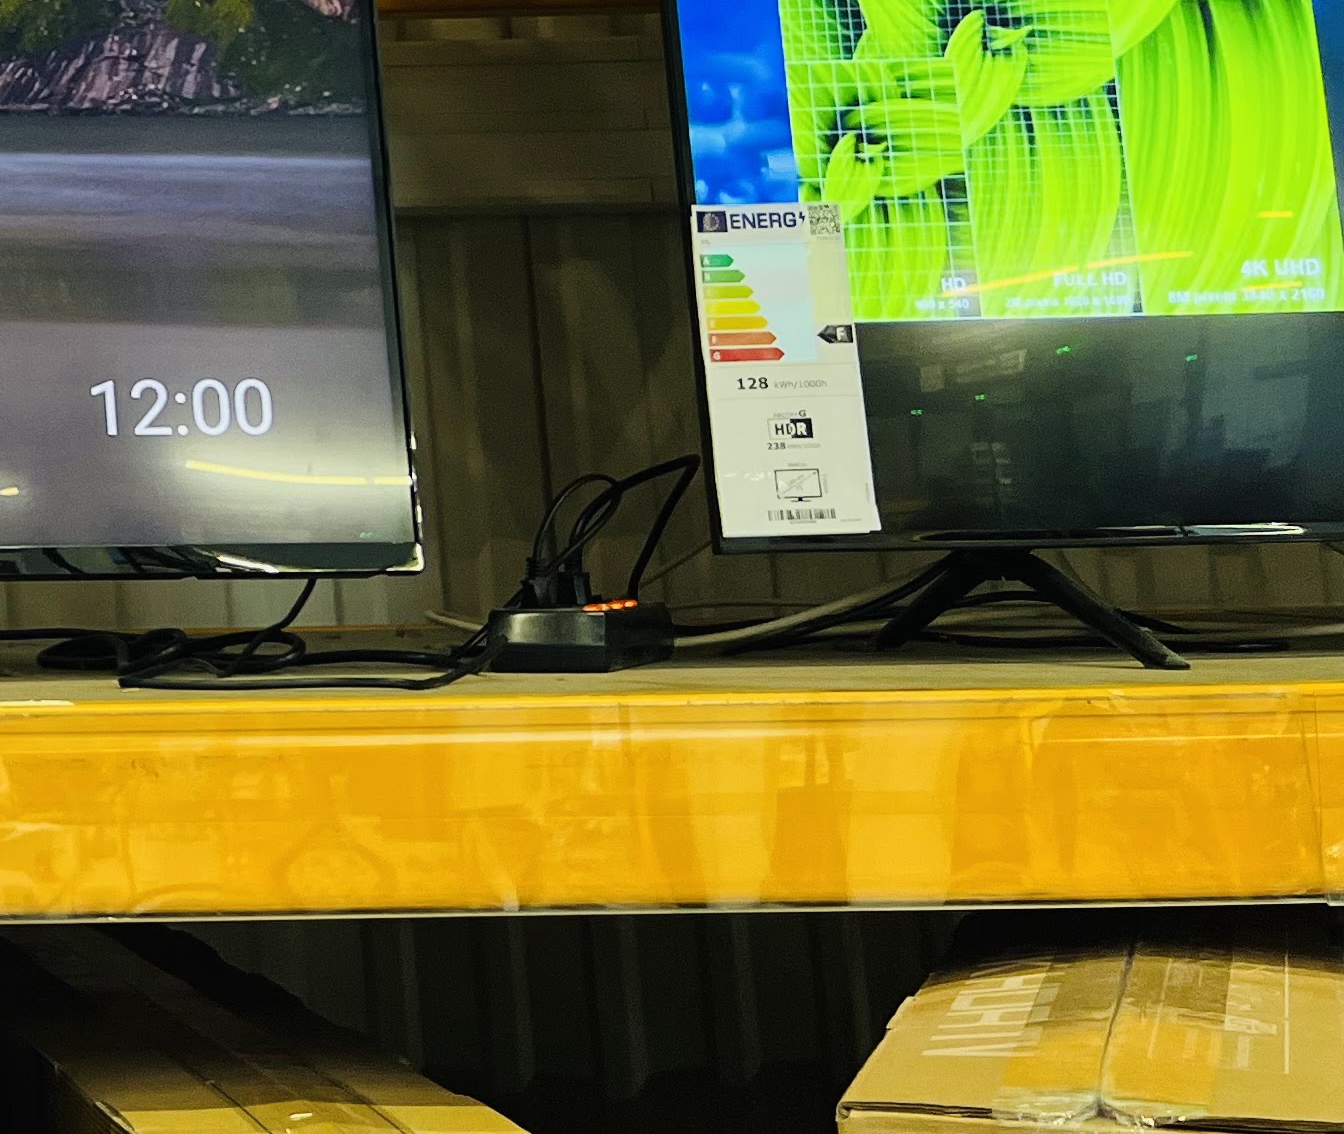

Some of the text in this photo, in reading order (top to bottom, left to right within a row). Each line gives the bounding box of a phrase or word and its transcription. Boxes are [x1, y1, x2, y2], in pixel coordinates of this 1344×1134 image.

[730, 210, 798, 231] ENERG
[1240, 257, 1322, 277] 4K UHD
[941, 277, 967, 292] HD
[1102, 271, 1127, 286] HD
[737, 377, 769, 390] 128
[90, 378, 274, 437] 12:00
[775, 422, 807, 436] HDR
[767, 442, 786, 450] 238
